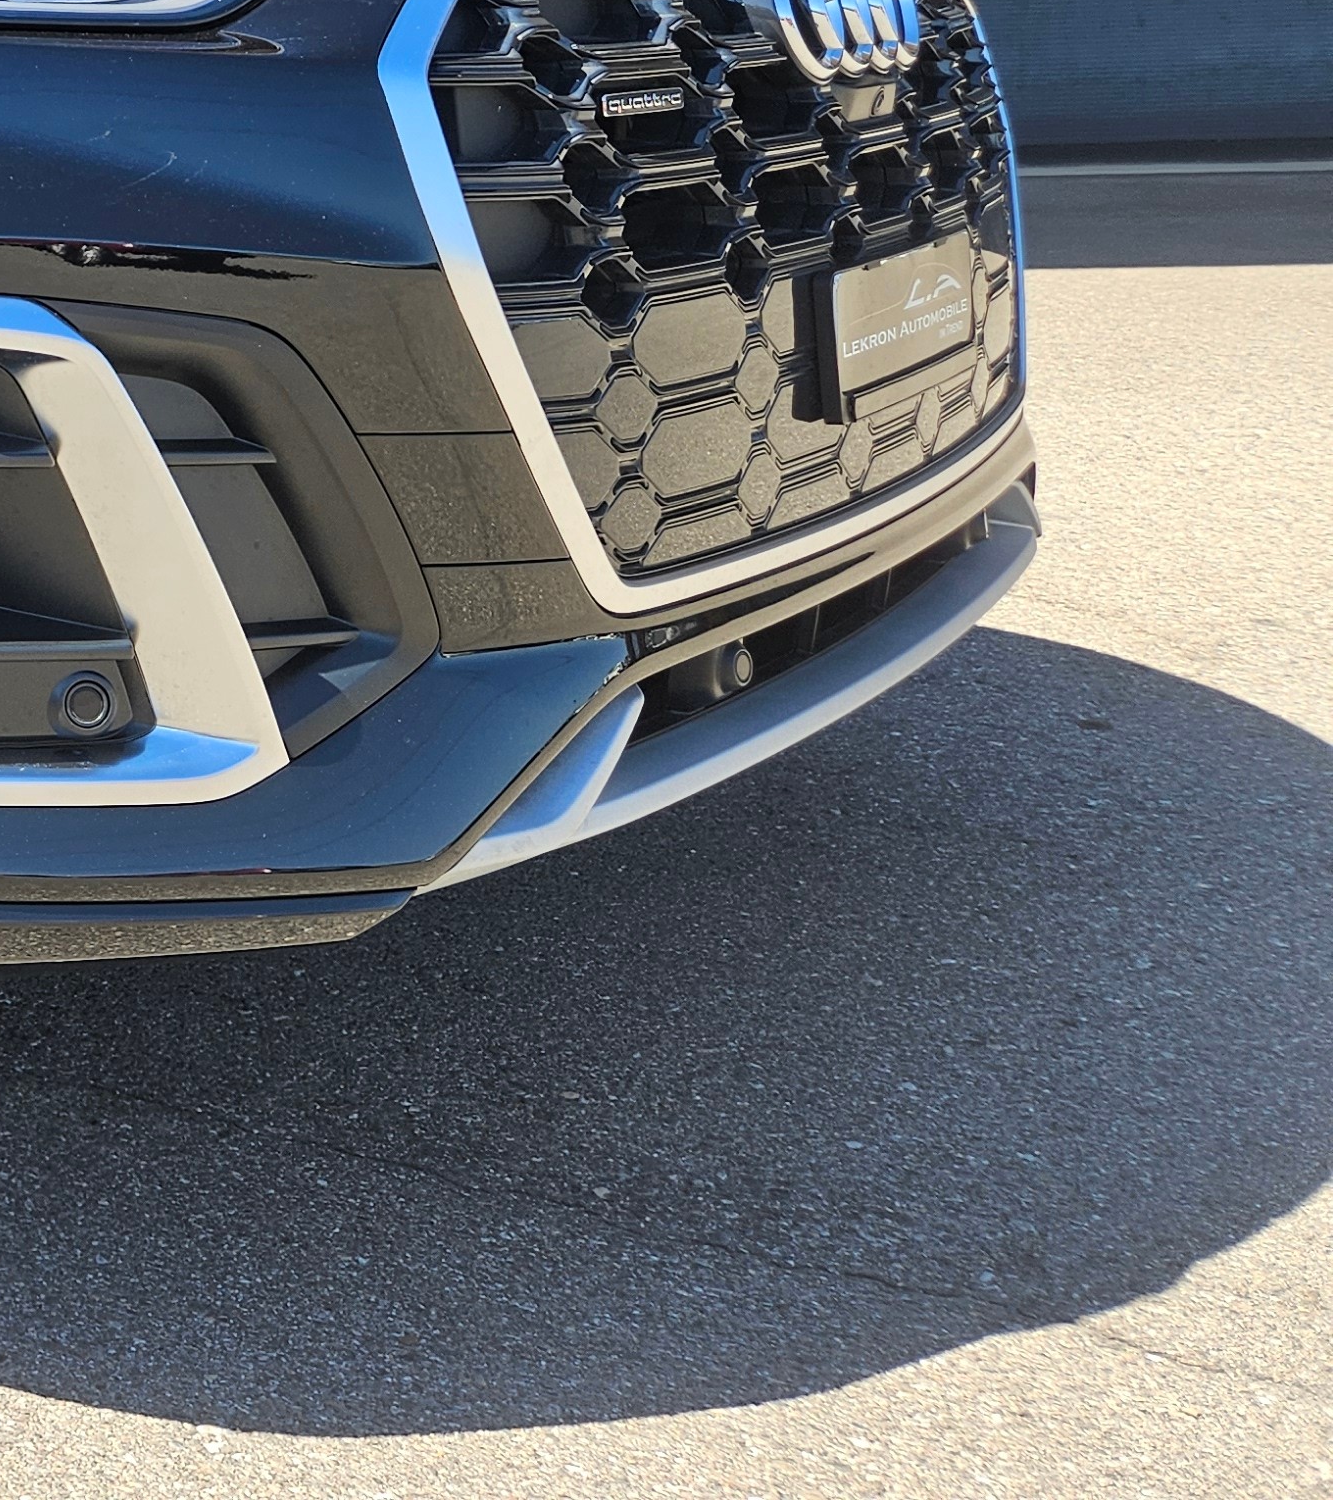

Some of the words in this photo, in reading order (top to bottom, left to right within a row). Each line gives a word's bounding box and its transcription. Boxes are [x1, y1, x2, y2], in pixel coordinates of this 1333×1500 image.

[608, 92, 682, 114] quattro
[842, 329, 897, 359] LEKRON
[899, 297, 969, 339] AUTOMOBILE
